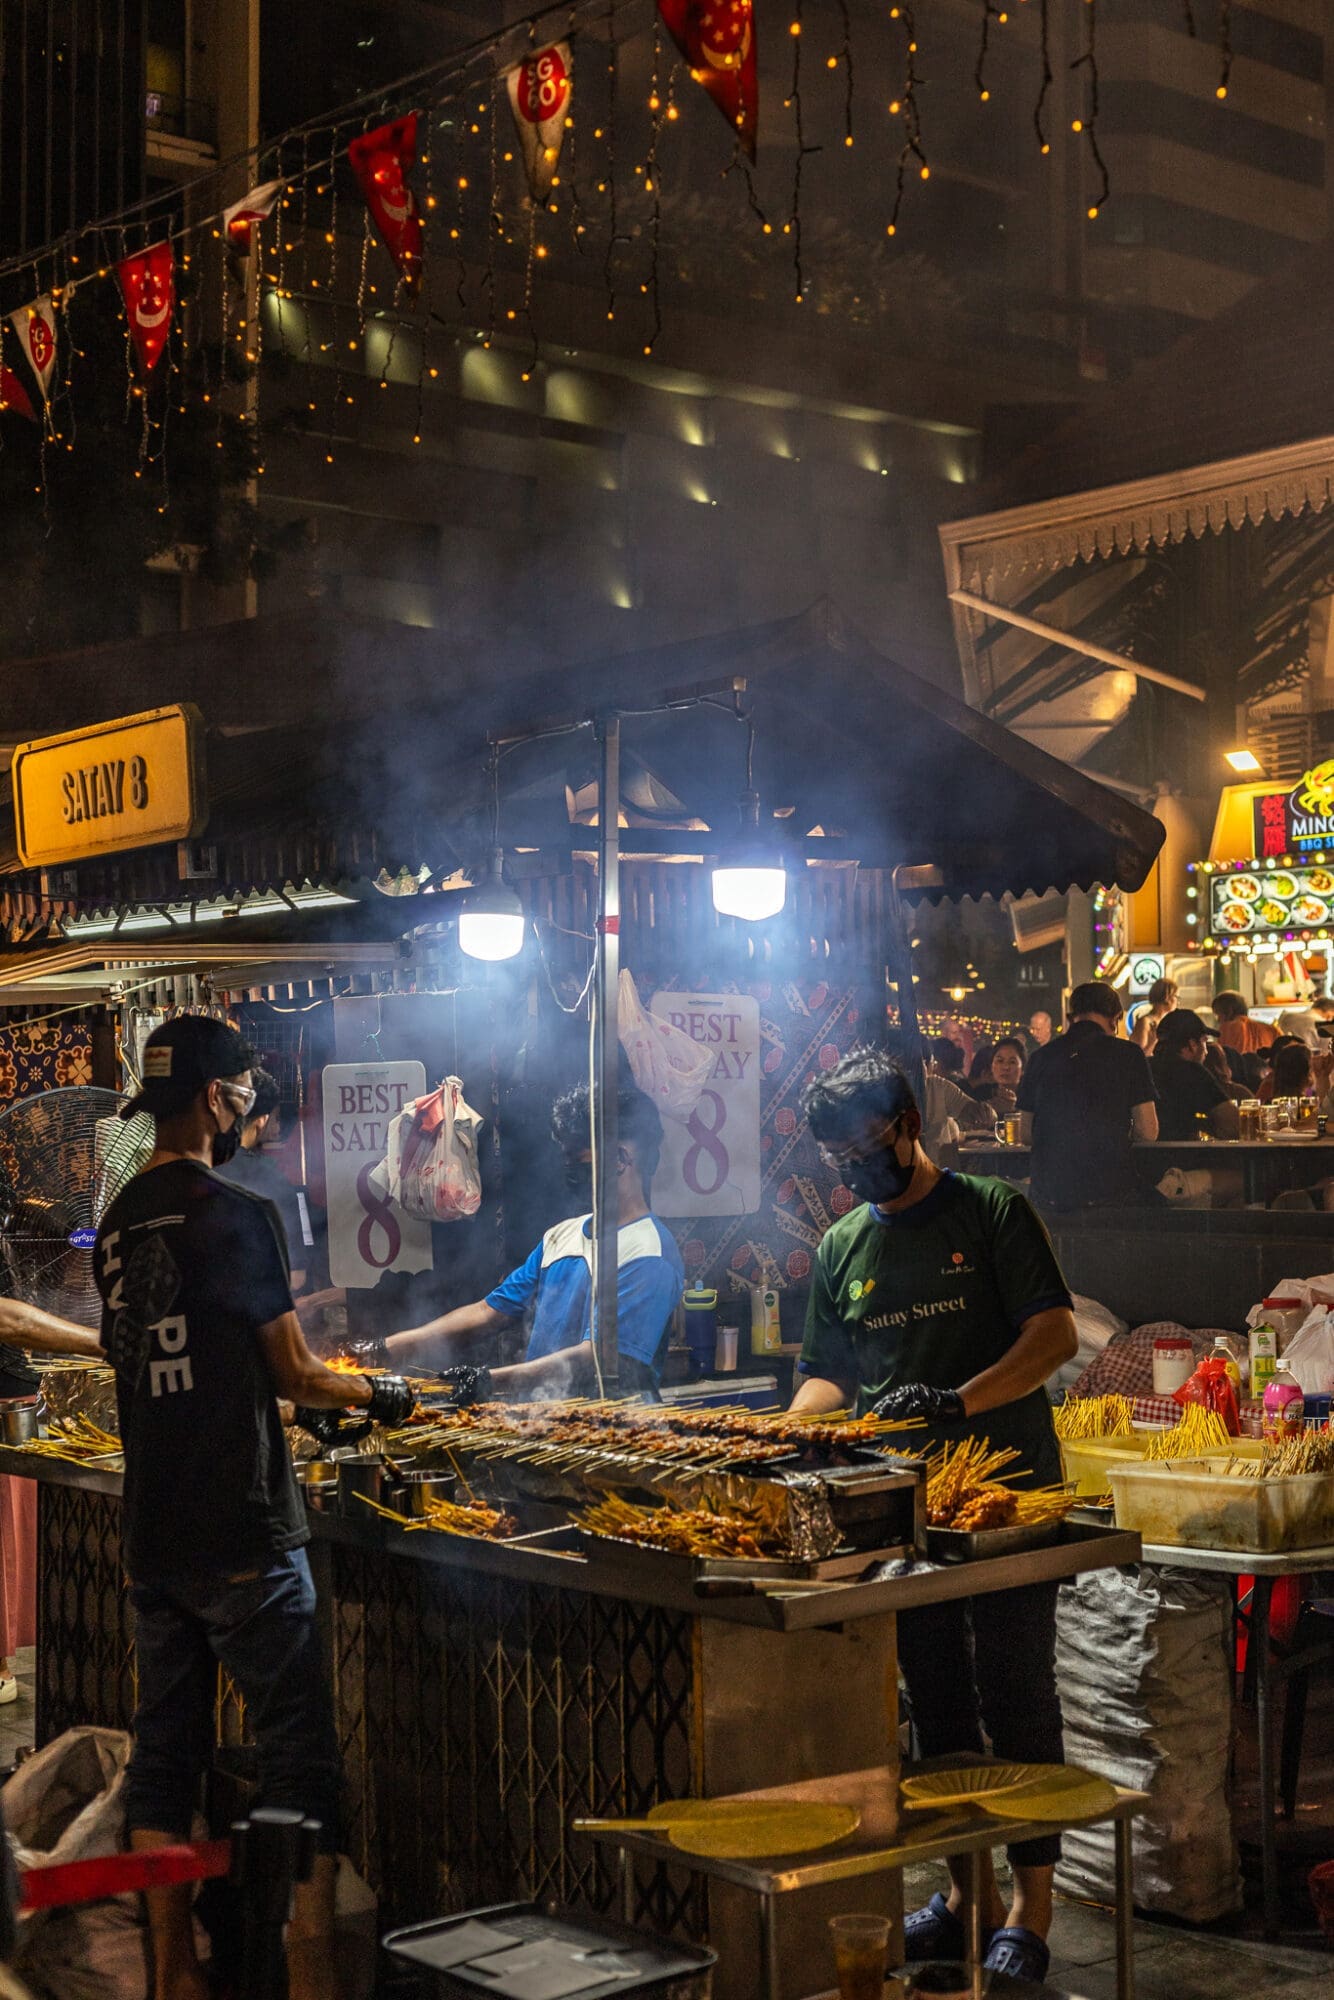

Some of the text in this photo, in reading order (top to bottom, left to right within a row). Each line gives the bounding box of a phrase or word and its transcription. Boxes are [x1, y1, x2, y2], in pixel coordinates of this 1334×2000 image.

[61, 755, 149, 824] SATAY 8
[1300, 838, 1322, 852] BBQ
[338, 1083, 408, 1115] BEST
[331, 1122, 389, 1152] SAT
[682, 1088, 729, 1195] 8
[356, 1160, 401, 1268] 8
[863, 1296, 966, 1332] Satay Street
